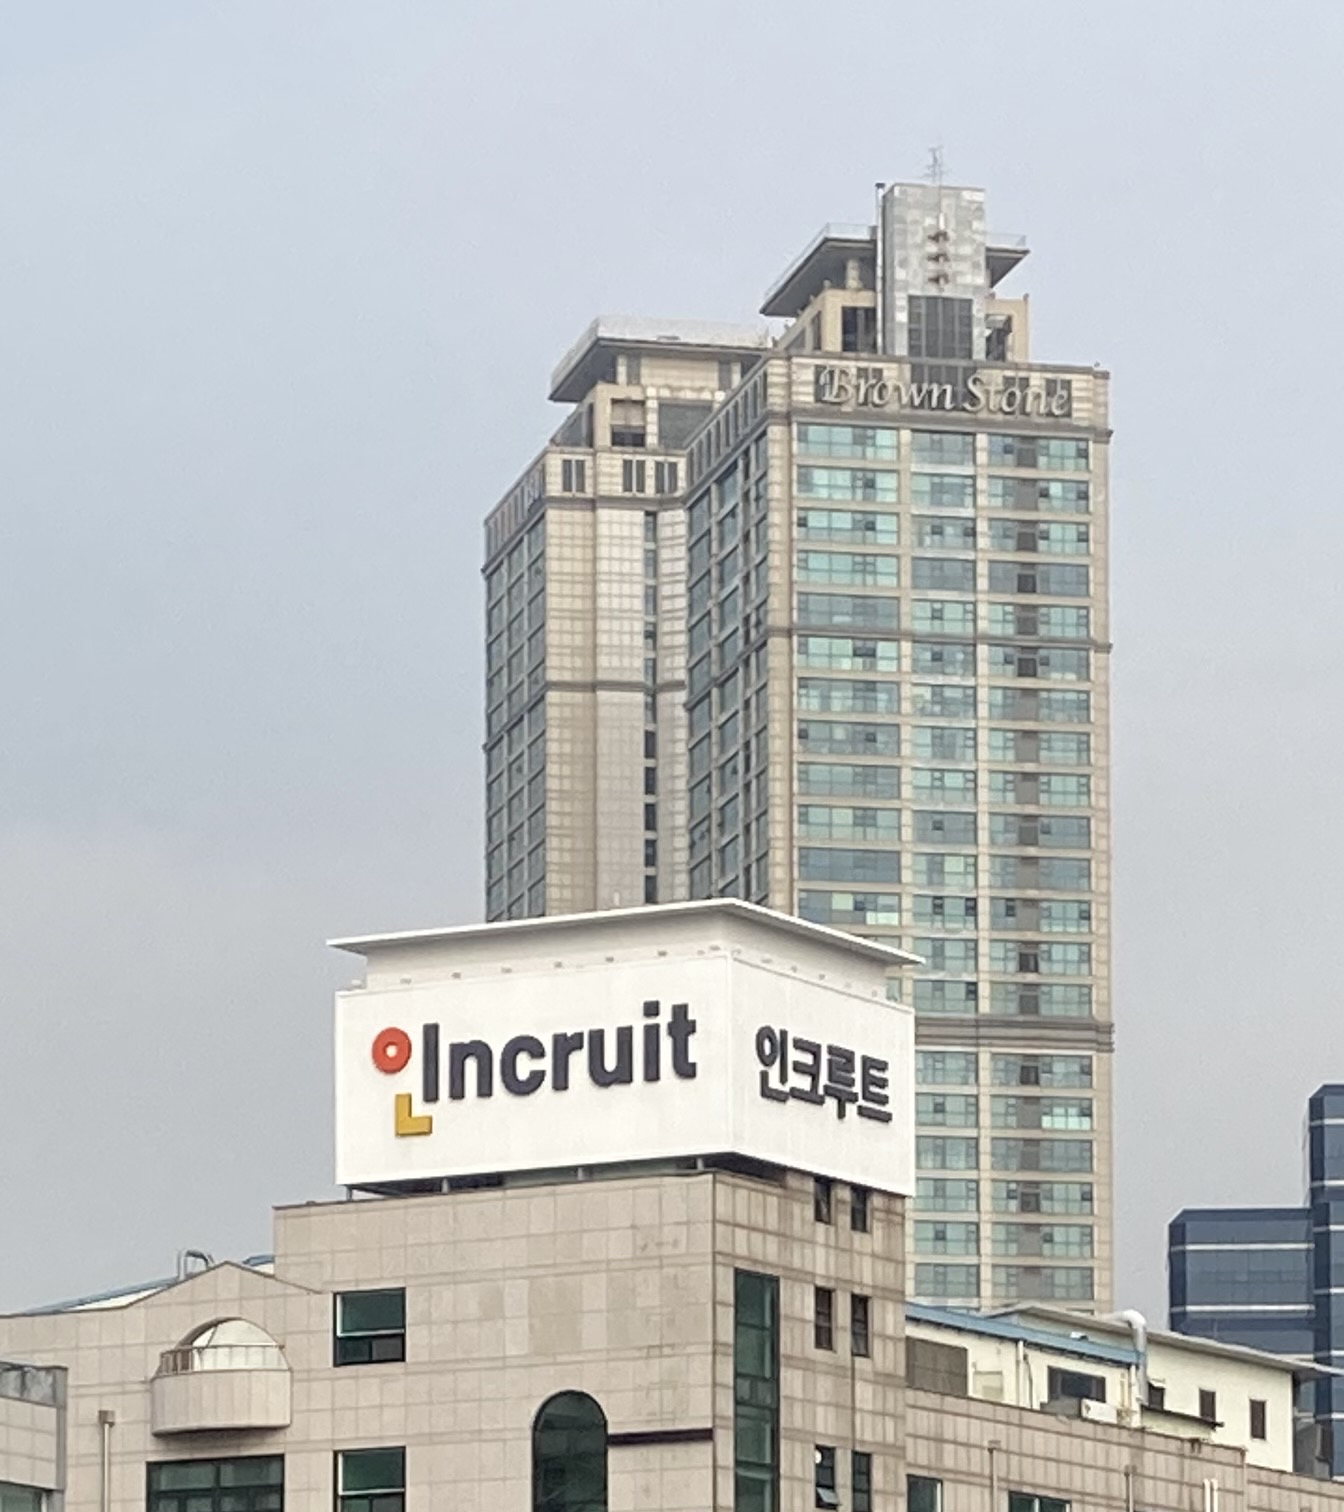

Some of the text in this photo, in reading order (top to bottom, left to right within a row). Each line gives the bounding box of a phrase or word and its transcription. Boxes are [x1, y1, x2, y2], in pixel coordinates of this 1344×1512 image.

[818, 364, 1071, 417] Brown Stone
[422, 1000, 697, 1104] Incruit
[755, 1024, 892, 1123] 인크루트
